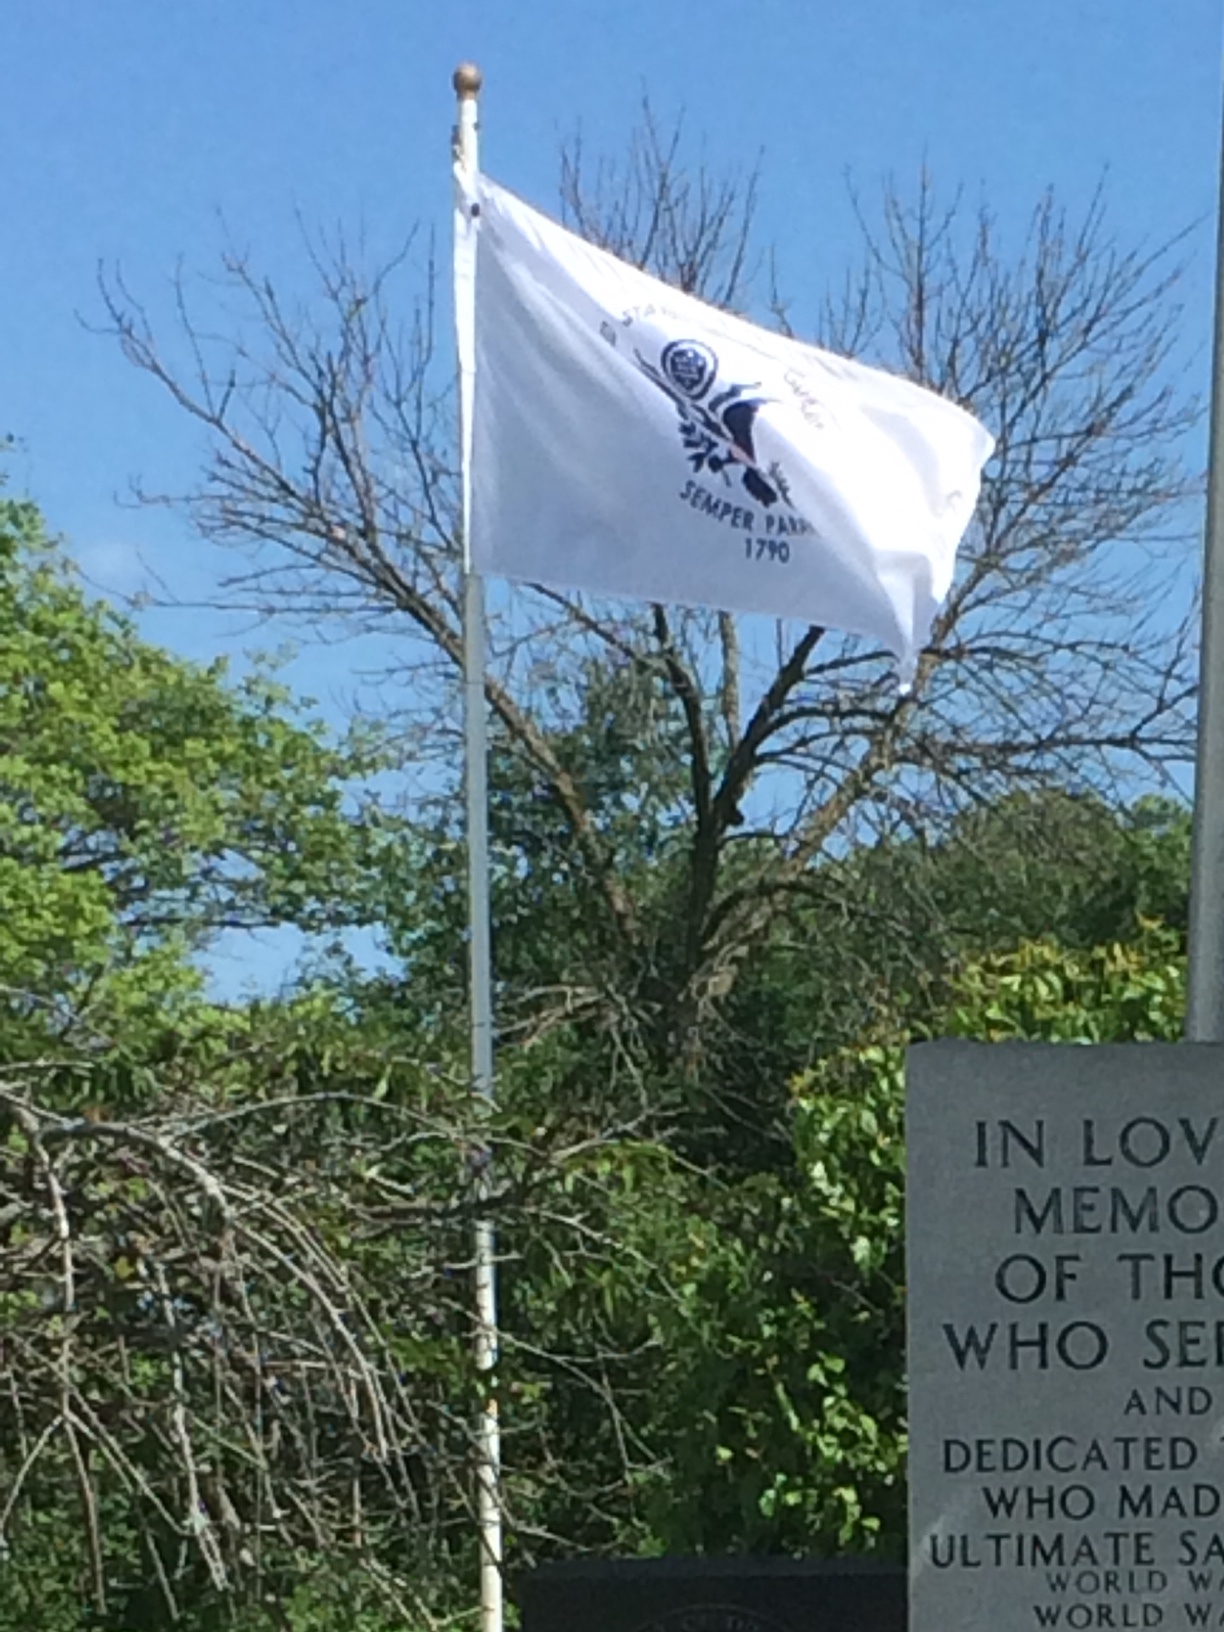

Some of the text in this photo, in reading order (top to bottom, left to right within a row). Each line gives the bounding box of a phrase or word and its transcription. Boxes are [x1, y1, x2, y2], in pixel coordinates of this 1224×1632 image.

[679, 480, 754, 531] SEMPER
[744, 537, 790, 564] 1790
[975, 1120, 1044, 1168] IN
[995, 1254, 1081, 1304] OF
[942, 1321, 1108, 1370] WHO
[1124, 1386, 1212, 1415] AND
[943, 1435, 1197, 1472] DEDICATED
[982, 1485, 1095, 1521] WHO
[930, 1532, 1155, 1568] ULTIMATE
[1046, 1570, 1167, 1594] WORLD
[1033, 1603, 1163, 1629] WORLD
